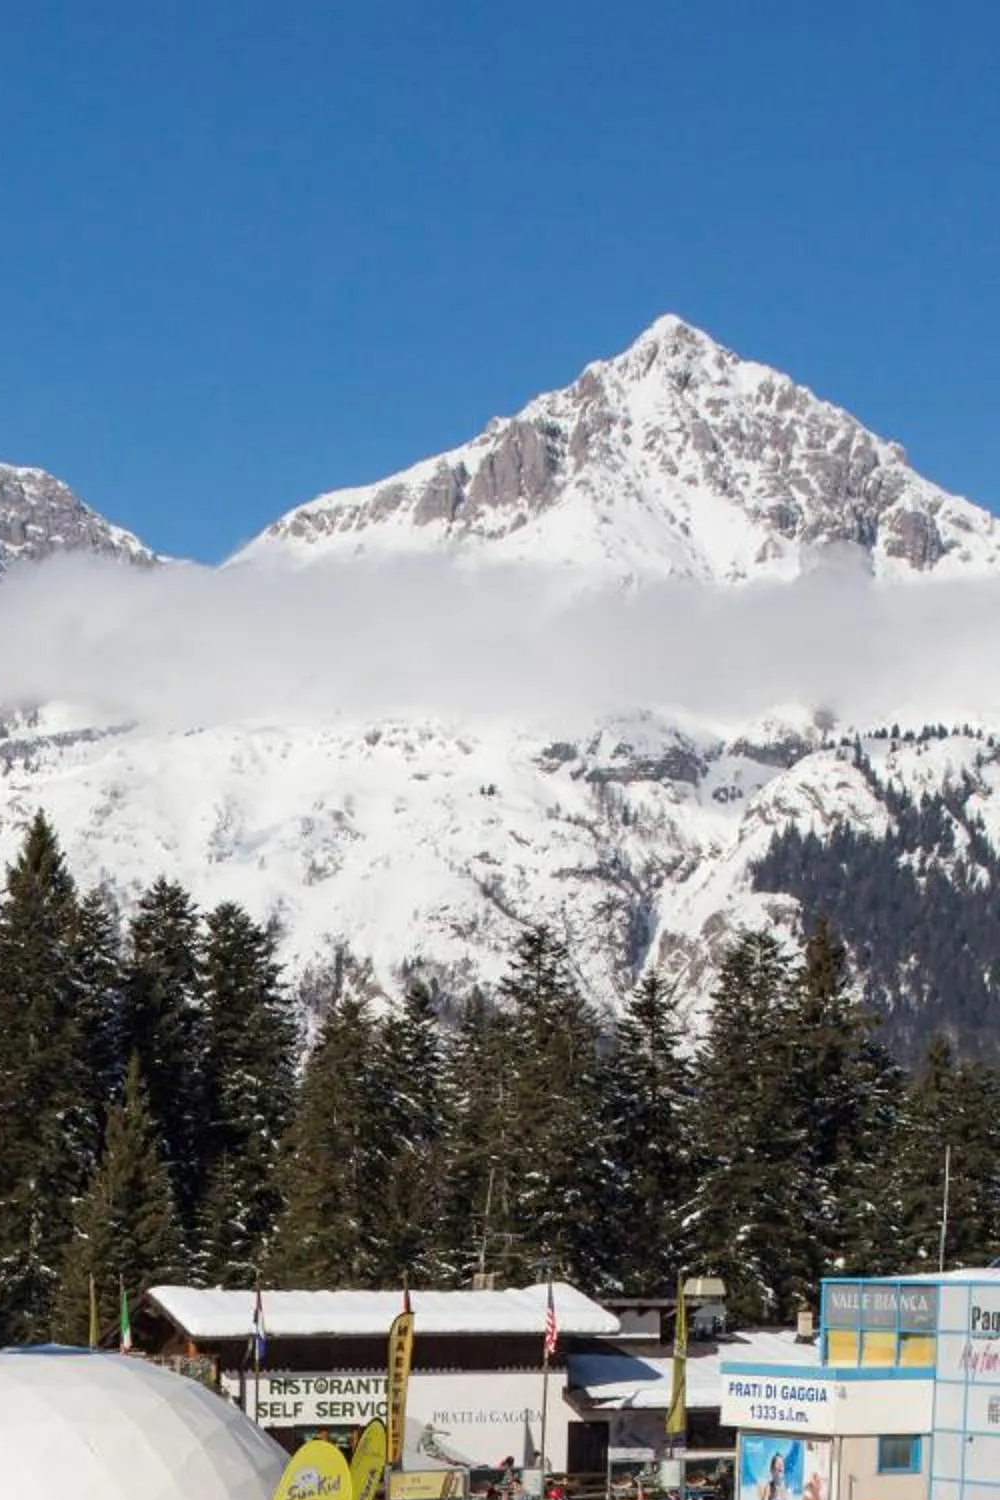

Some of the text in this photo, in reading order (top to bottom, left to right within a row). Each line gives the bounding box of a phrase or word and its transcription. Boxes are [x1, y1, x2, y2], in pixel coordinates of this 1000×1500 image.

[728, 1381, 762, 1398] PRATI
[765, 1384, 777, 1399] DI
[781, 1385, 828, 1402] GAGGIA
[256, 1401, 389, 1418] SELF SERVIC
[750, 1404, 777, 1420] 1333
